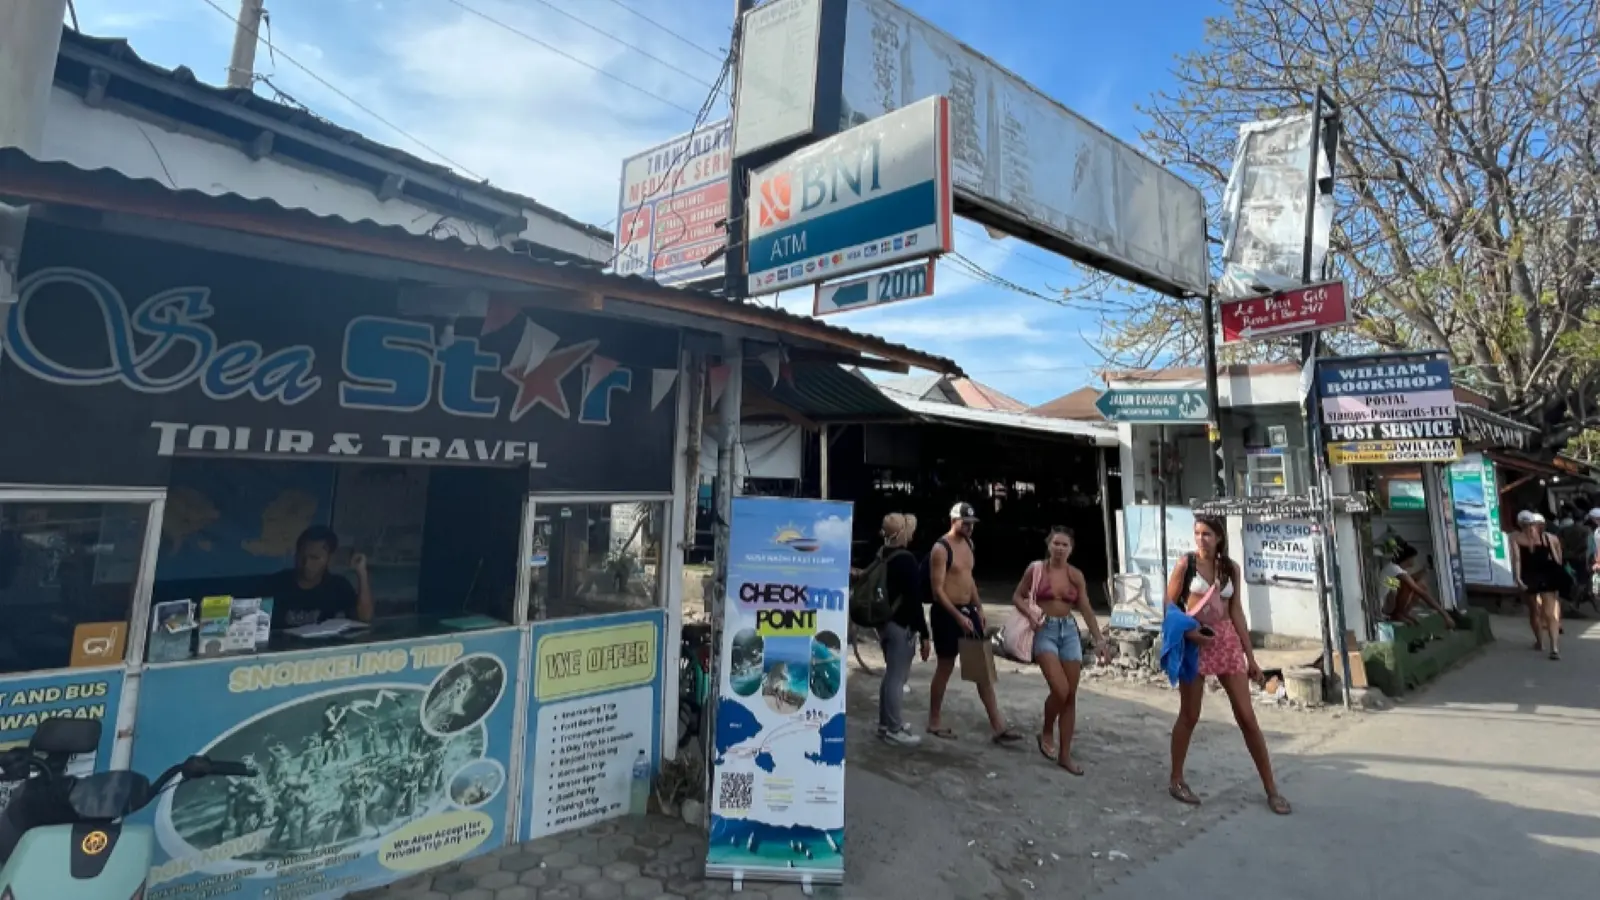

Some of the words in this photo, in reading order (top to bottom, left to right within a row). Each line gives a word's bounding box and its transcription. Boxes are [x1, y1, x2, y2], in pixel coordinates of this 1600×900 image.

[801, 138, 881, 212] BNI
[770, 230, 807, 261] ATM
[2, 266, 322, 406] Sea
[1338, 363, 1426, 380] WILLIAM
[1326, 375, 1442, 393] BOOKSHOP
[1365, 394, 1408, 406] POSTAL
[1330, 423, 1375, 440] POST
[1380, 420, 1454, 438] SERVICE
[328, 433, 363, 455] &
[382, 434, 548, 469] TRAVEL
[1246, 523, 1280, 534] BOOK
[1286, 524, 1311, 536] SHO
[1262, 540, 1308, 553] POSTAL
[1248, 557, 1275, 570] POST
[1277, 560, 1317, 573] SERVIC
[739, 582, 808, 605] CHECK
[756, 608, 817, 631] POINT
[229, 648, 407, 692] SNORKELING
[410, 642, 464, 670] TRIP
[546, 649, 583, 679] WE
[586, 640, 649, 674] OFFER
[10, 687, 61, 707] AND
[65, 682, 108, 700] BUS
[412, 832, 433, 844] Also
[386, 843, 422, 861] Private
[424, 839, 443, 852] Trip
